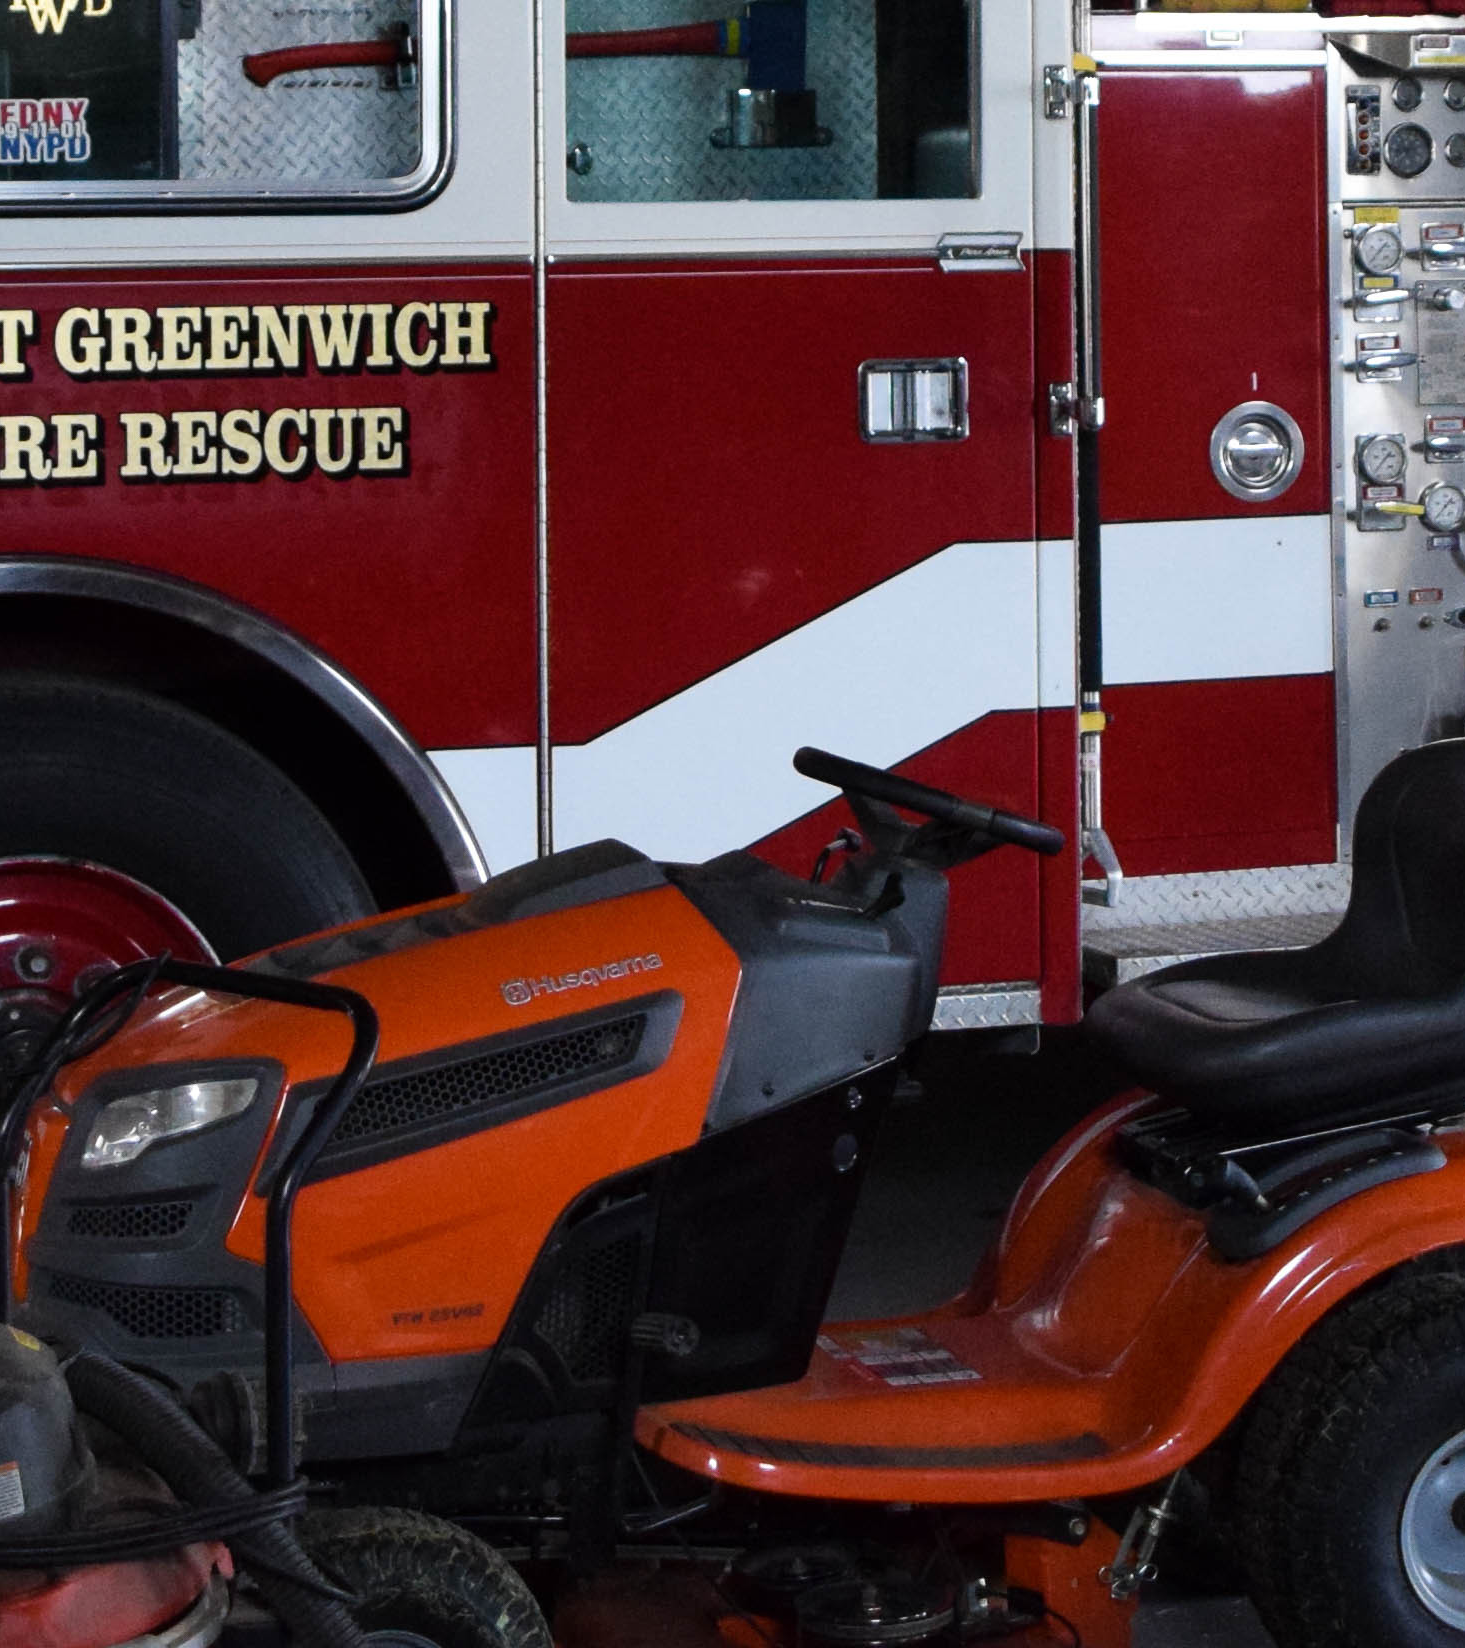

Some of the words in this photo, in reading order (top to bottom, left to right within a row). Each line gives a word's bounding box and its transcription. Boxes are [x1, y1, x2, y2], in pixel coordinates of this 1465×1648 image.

[4, 121, 87, 139] 9-11-01
[54, 302, 494, 375] GREENWICH
[119, 407, 406, 477] RESCUE
[528, 952, 664, 996] Husqvarna
